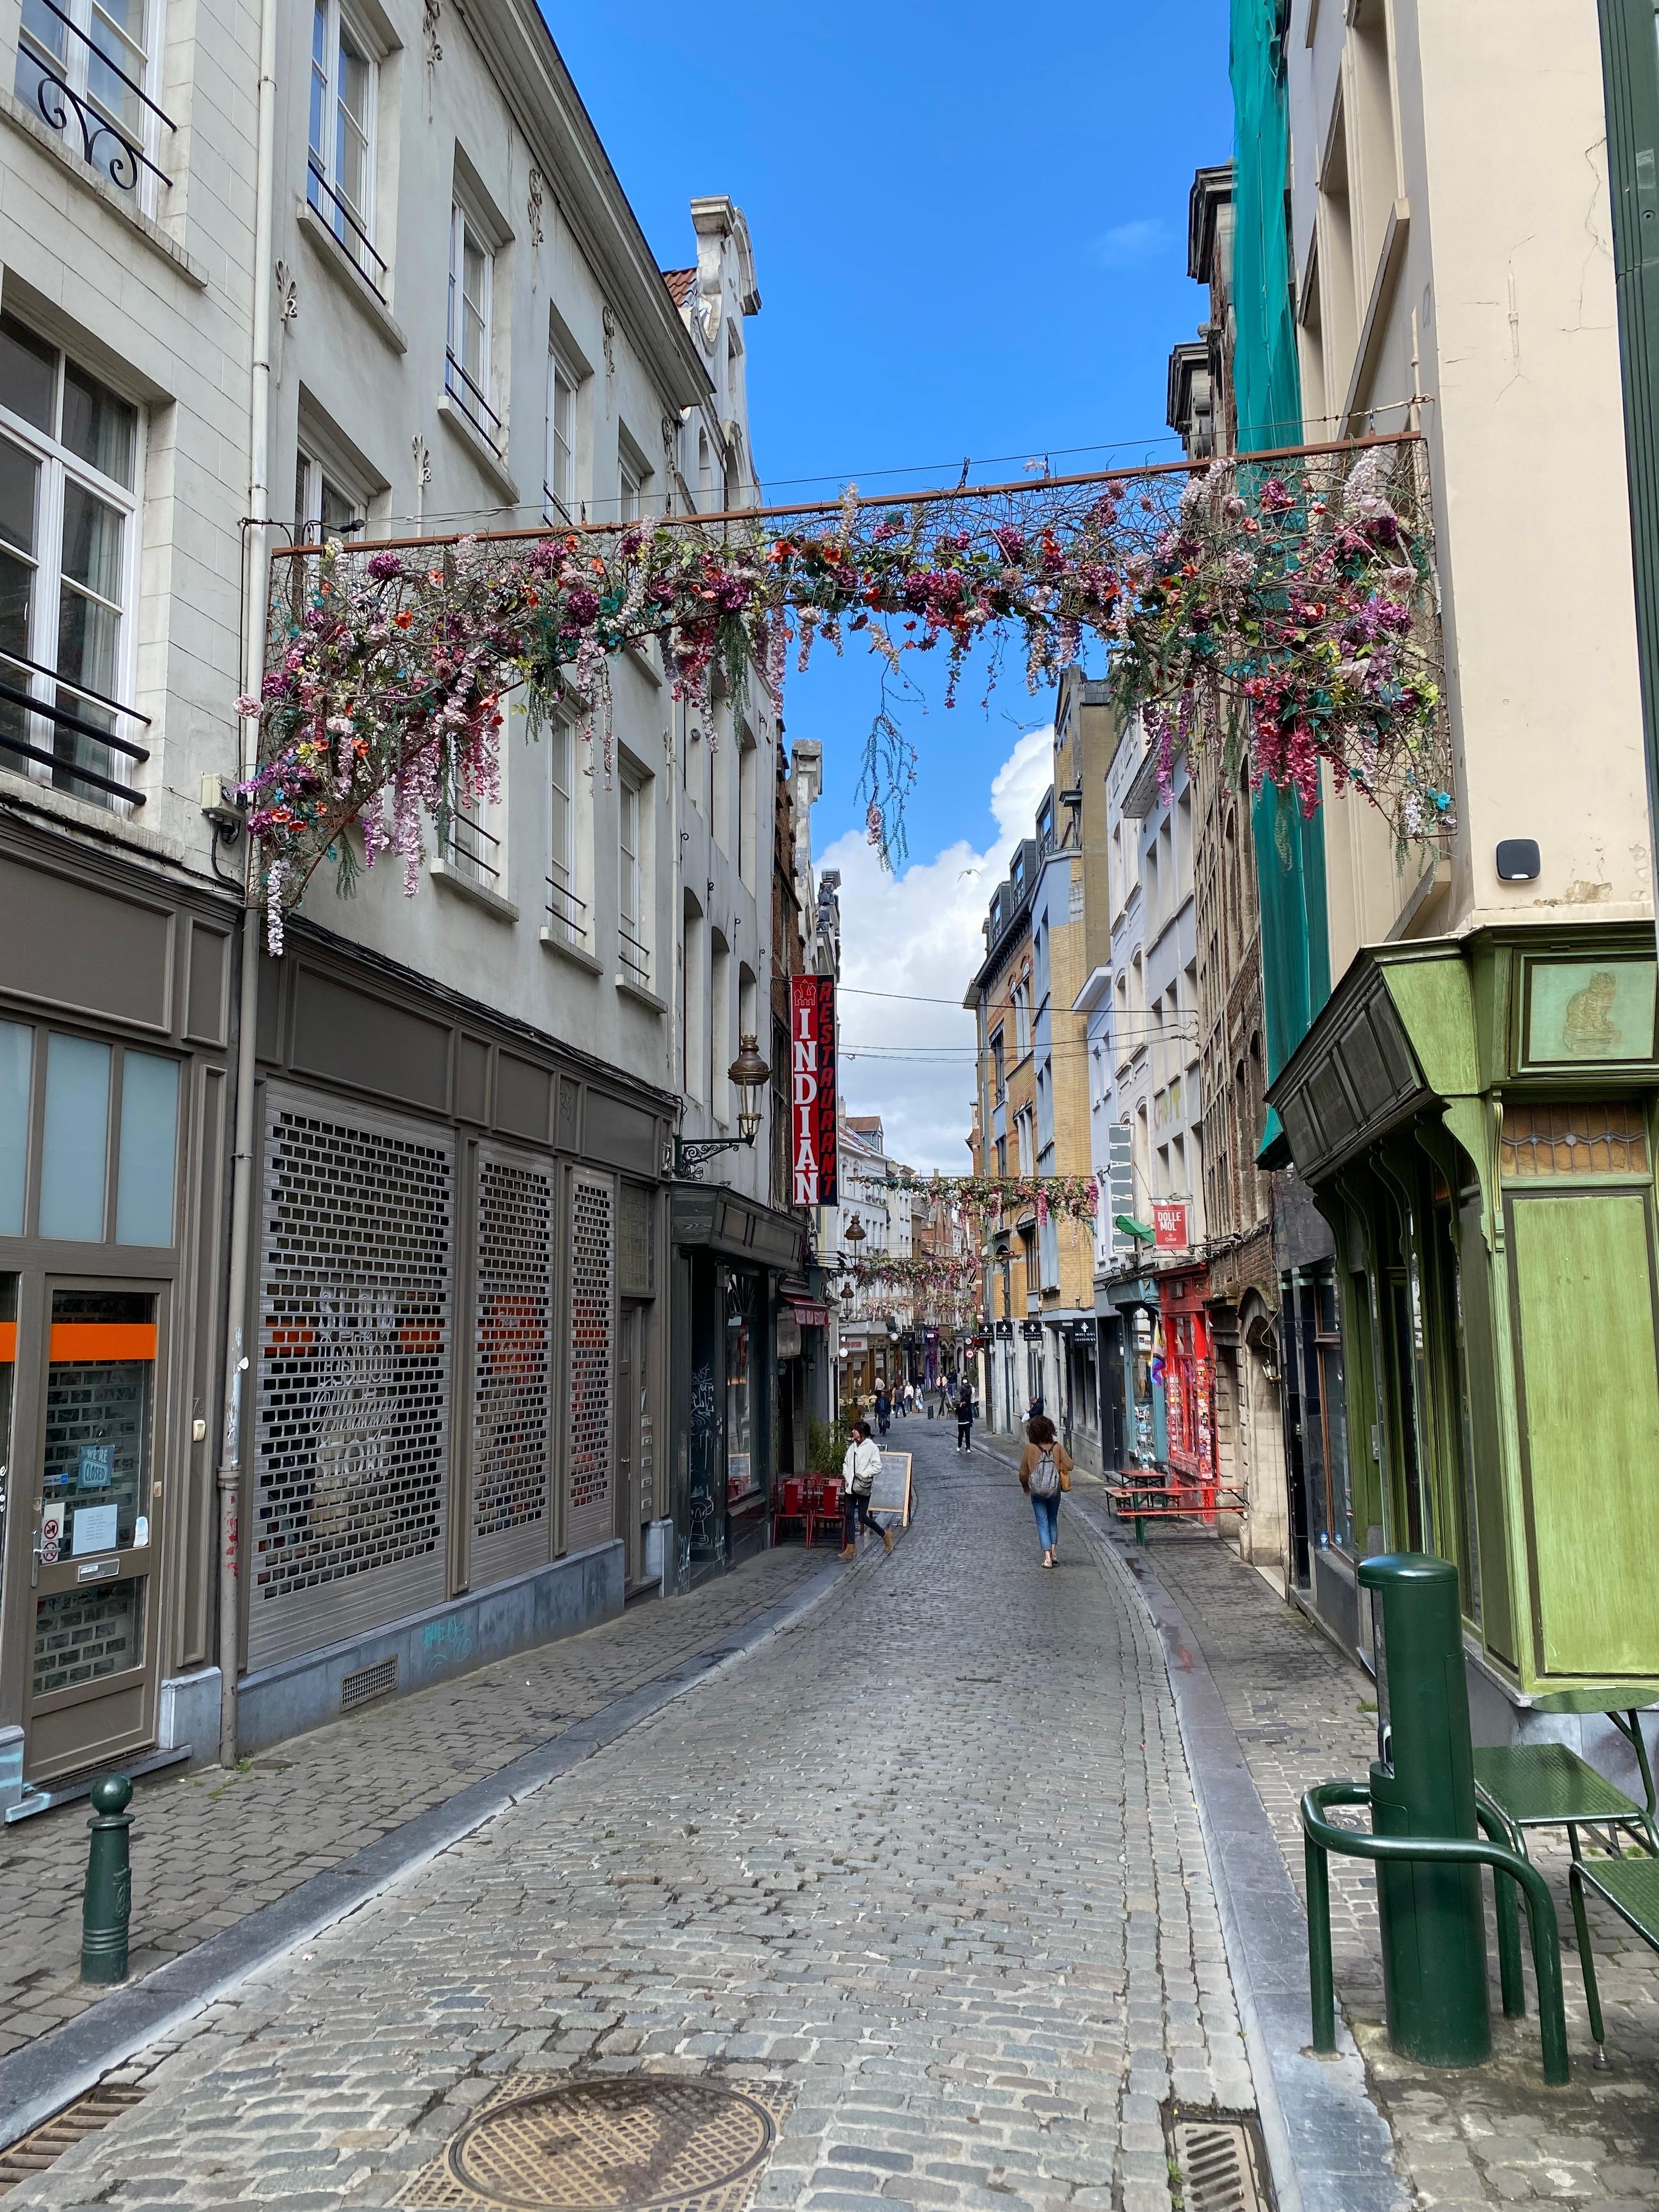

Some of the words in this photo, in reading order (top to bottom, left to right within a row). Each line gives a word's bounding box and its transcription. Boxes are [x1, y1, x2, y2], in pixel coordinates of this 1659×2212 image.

[819, 980, 836, 1197] RESTAURANT
[793, 1008, 819, 1205] INDIAN
[1158, 1211, 1182, 1222] DOLLE
[1160, 1221, 1177, 1232] MOL
[84, 1463, 105, 1481] CLOSED
